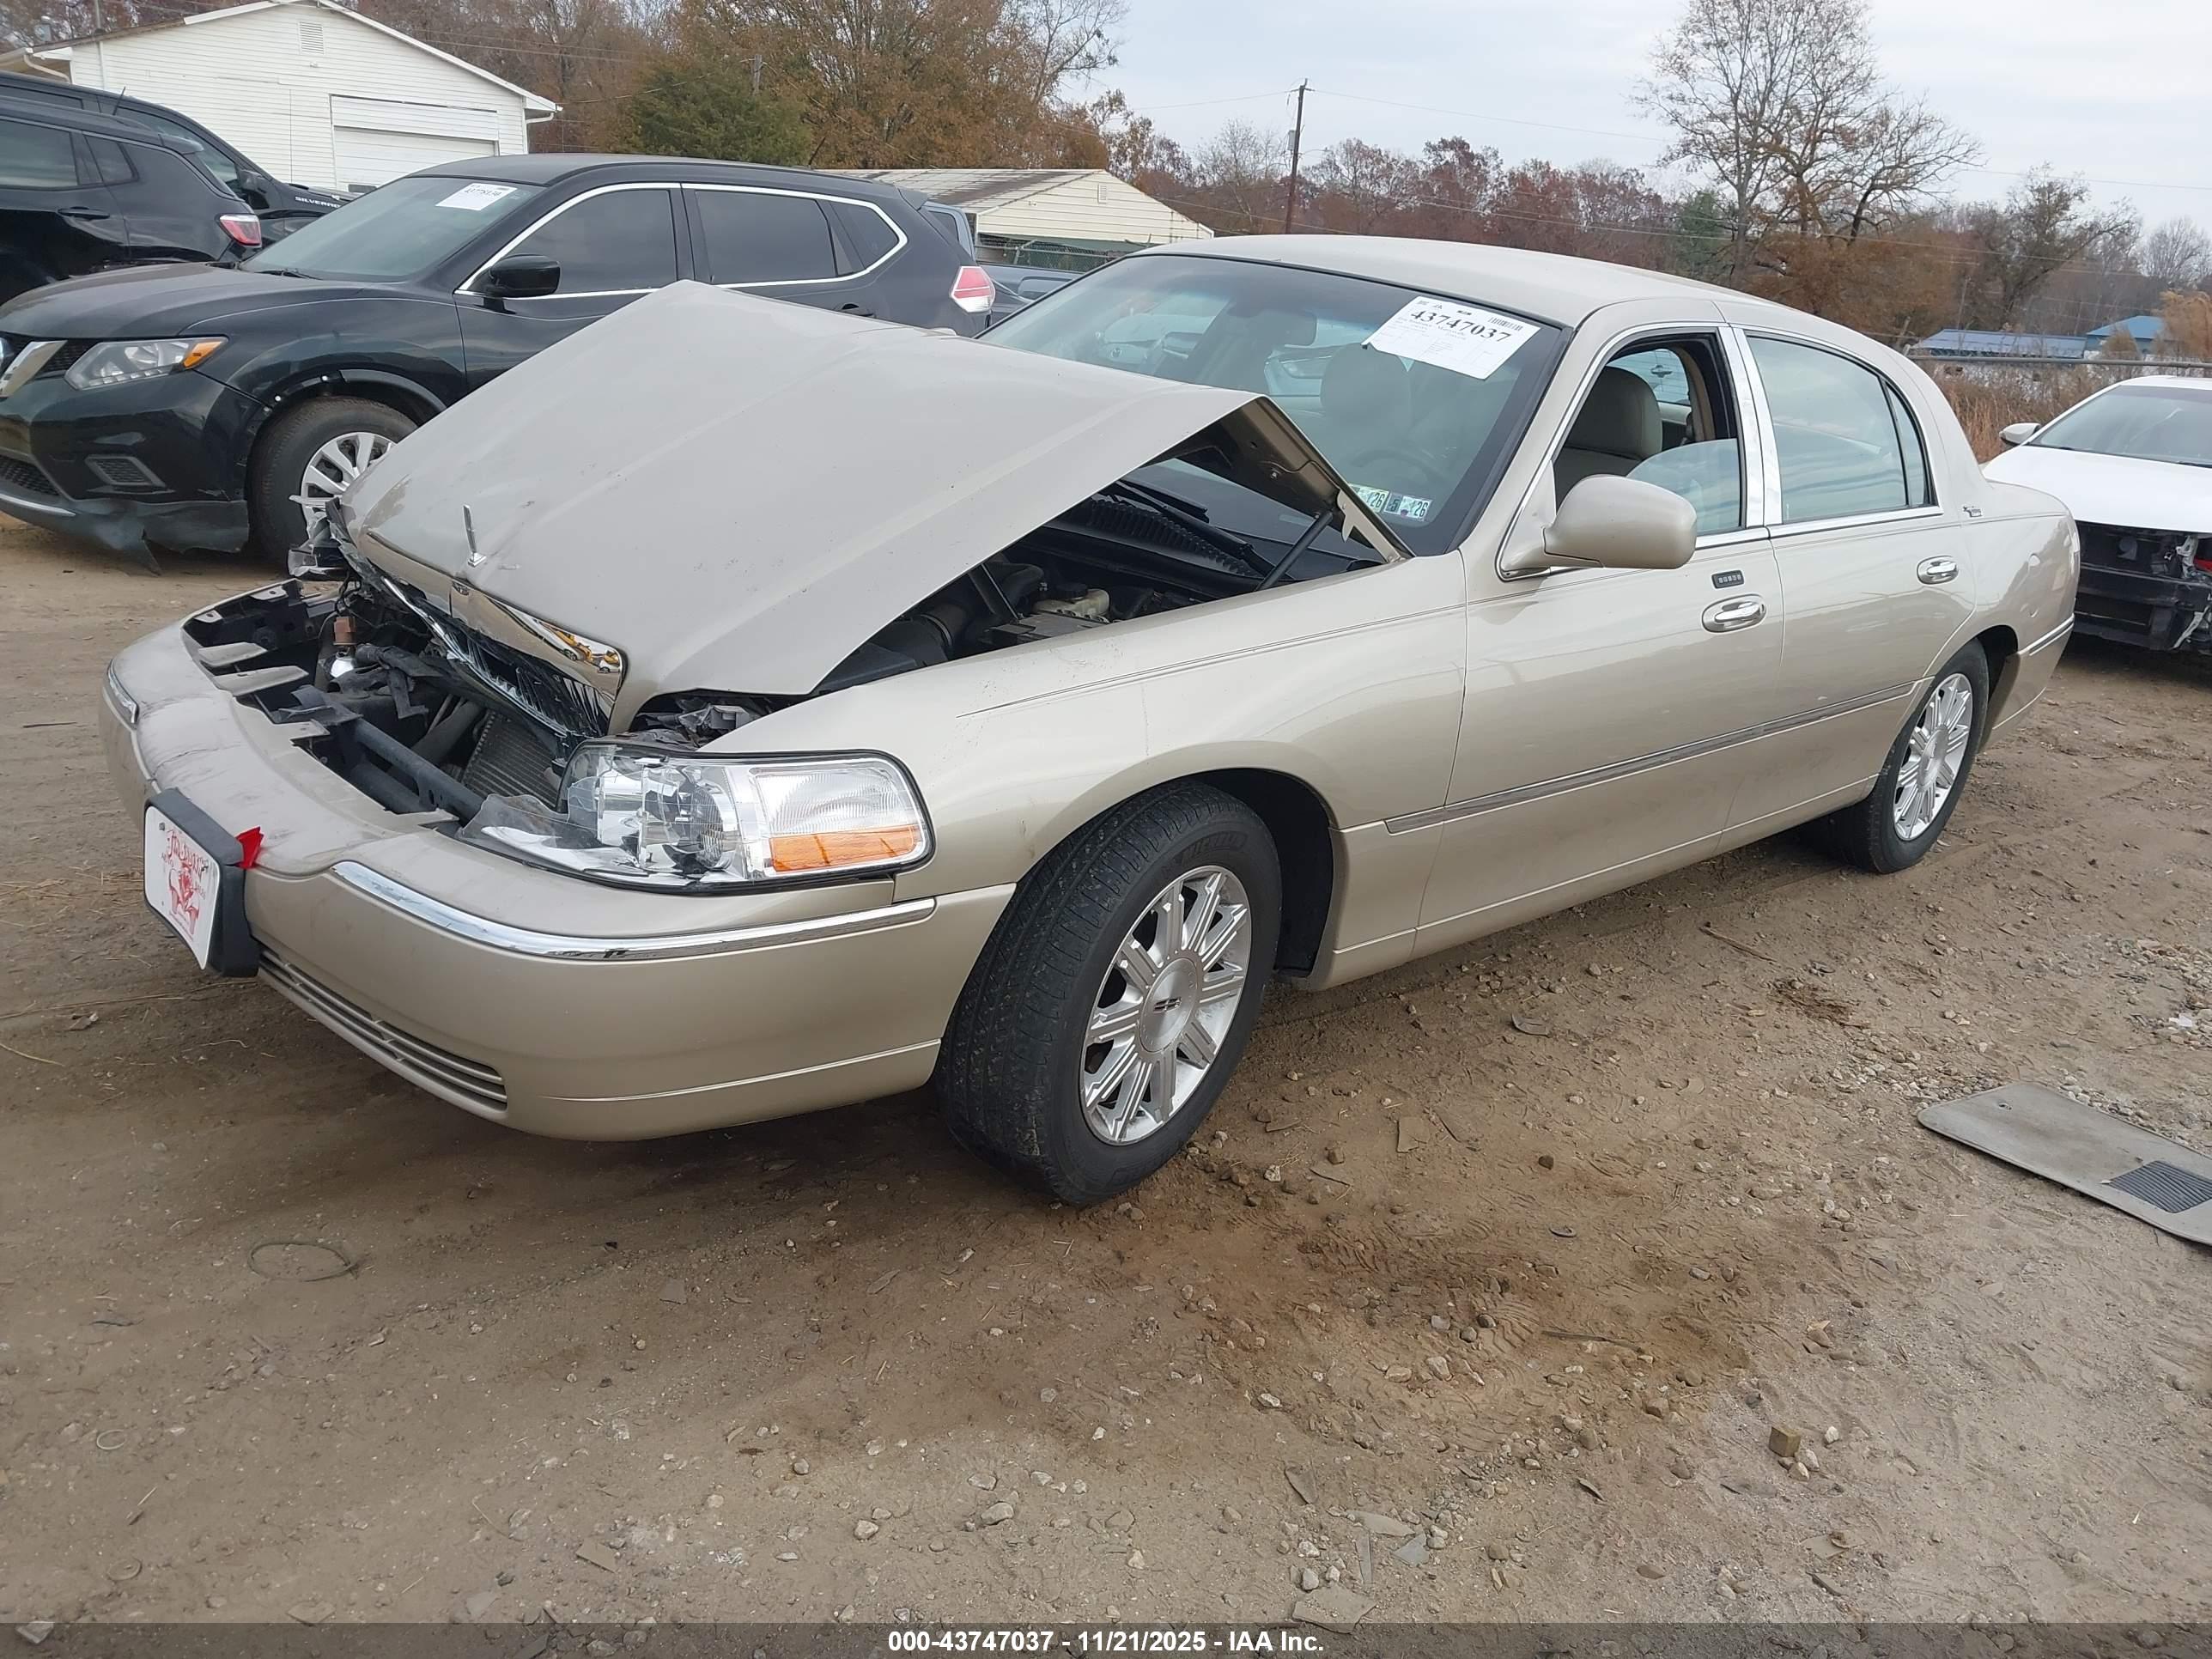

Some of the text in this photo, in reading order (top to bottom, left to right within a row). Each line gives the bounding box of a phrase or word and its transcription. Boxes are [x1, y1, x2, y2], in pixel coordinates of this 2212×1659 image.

[295, 196, 342, 209] SILVERAD
[1411, 309, 1512, 342] 43747037
[1370, 492, 1385, 508] 26
[1413, 501, 1429, 518] 26
